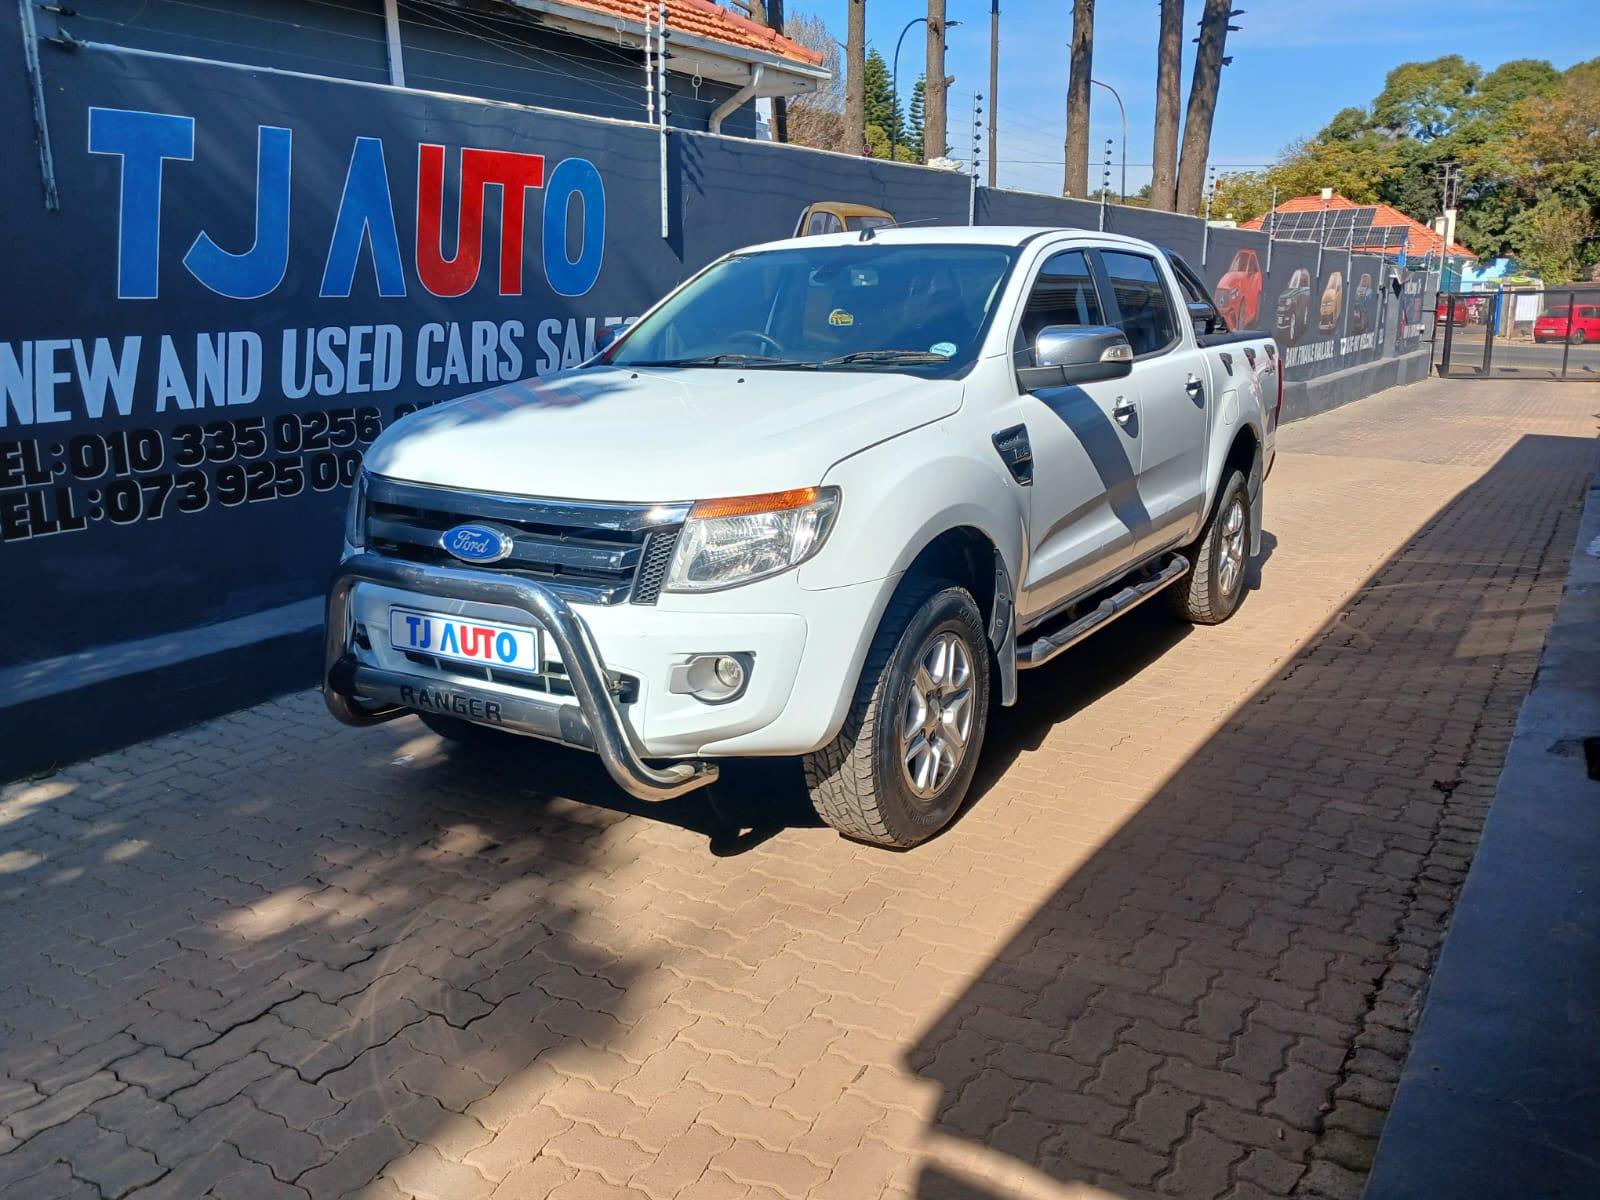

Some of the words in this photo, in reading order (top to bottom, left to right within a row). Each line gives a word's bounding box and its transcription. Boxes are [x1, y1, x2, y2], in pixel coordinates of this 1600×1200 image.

[88, 106, 292, 299] TJ
[319, 136, 606, 298] AUTO
[0, 336, 141, 427] NEW
[156, 331, 262, 413] AND
[281, 324, 402, 399] USED
[415, 320, 524, 388] CARS
[536, 317, 640, 376] SAL
[172, 416, 267, 468] 335
[274, 407, 383, 453] 0256
[217, 456, 304, 507] 925
[453, 530, 490, 553] Ford
[406, 616, 431, 648] TJ
[440, 623, 518, 663] AUTO
[400, 684, 502, 722] RANGER
